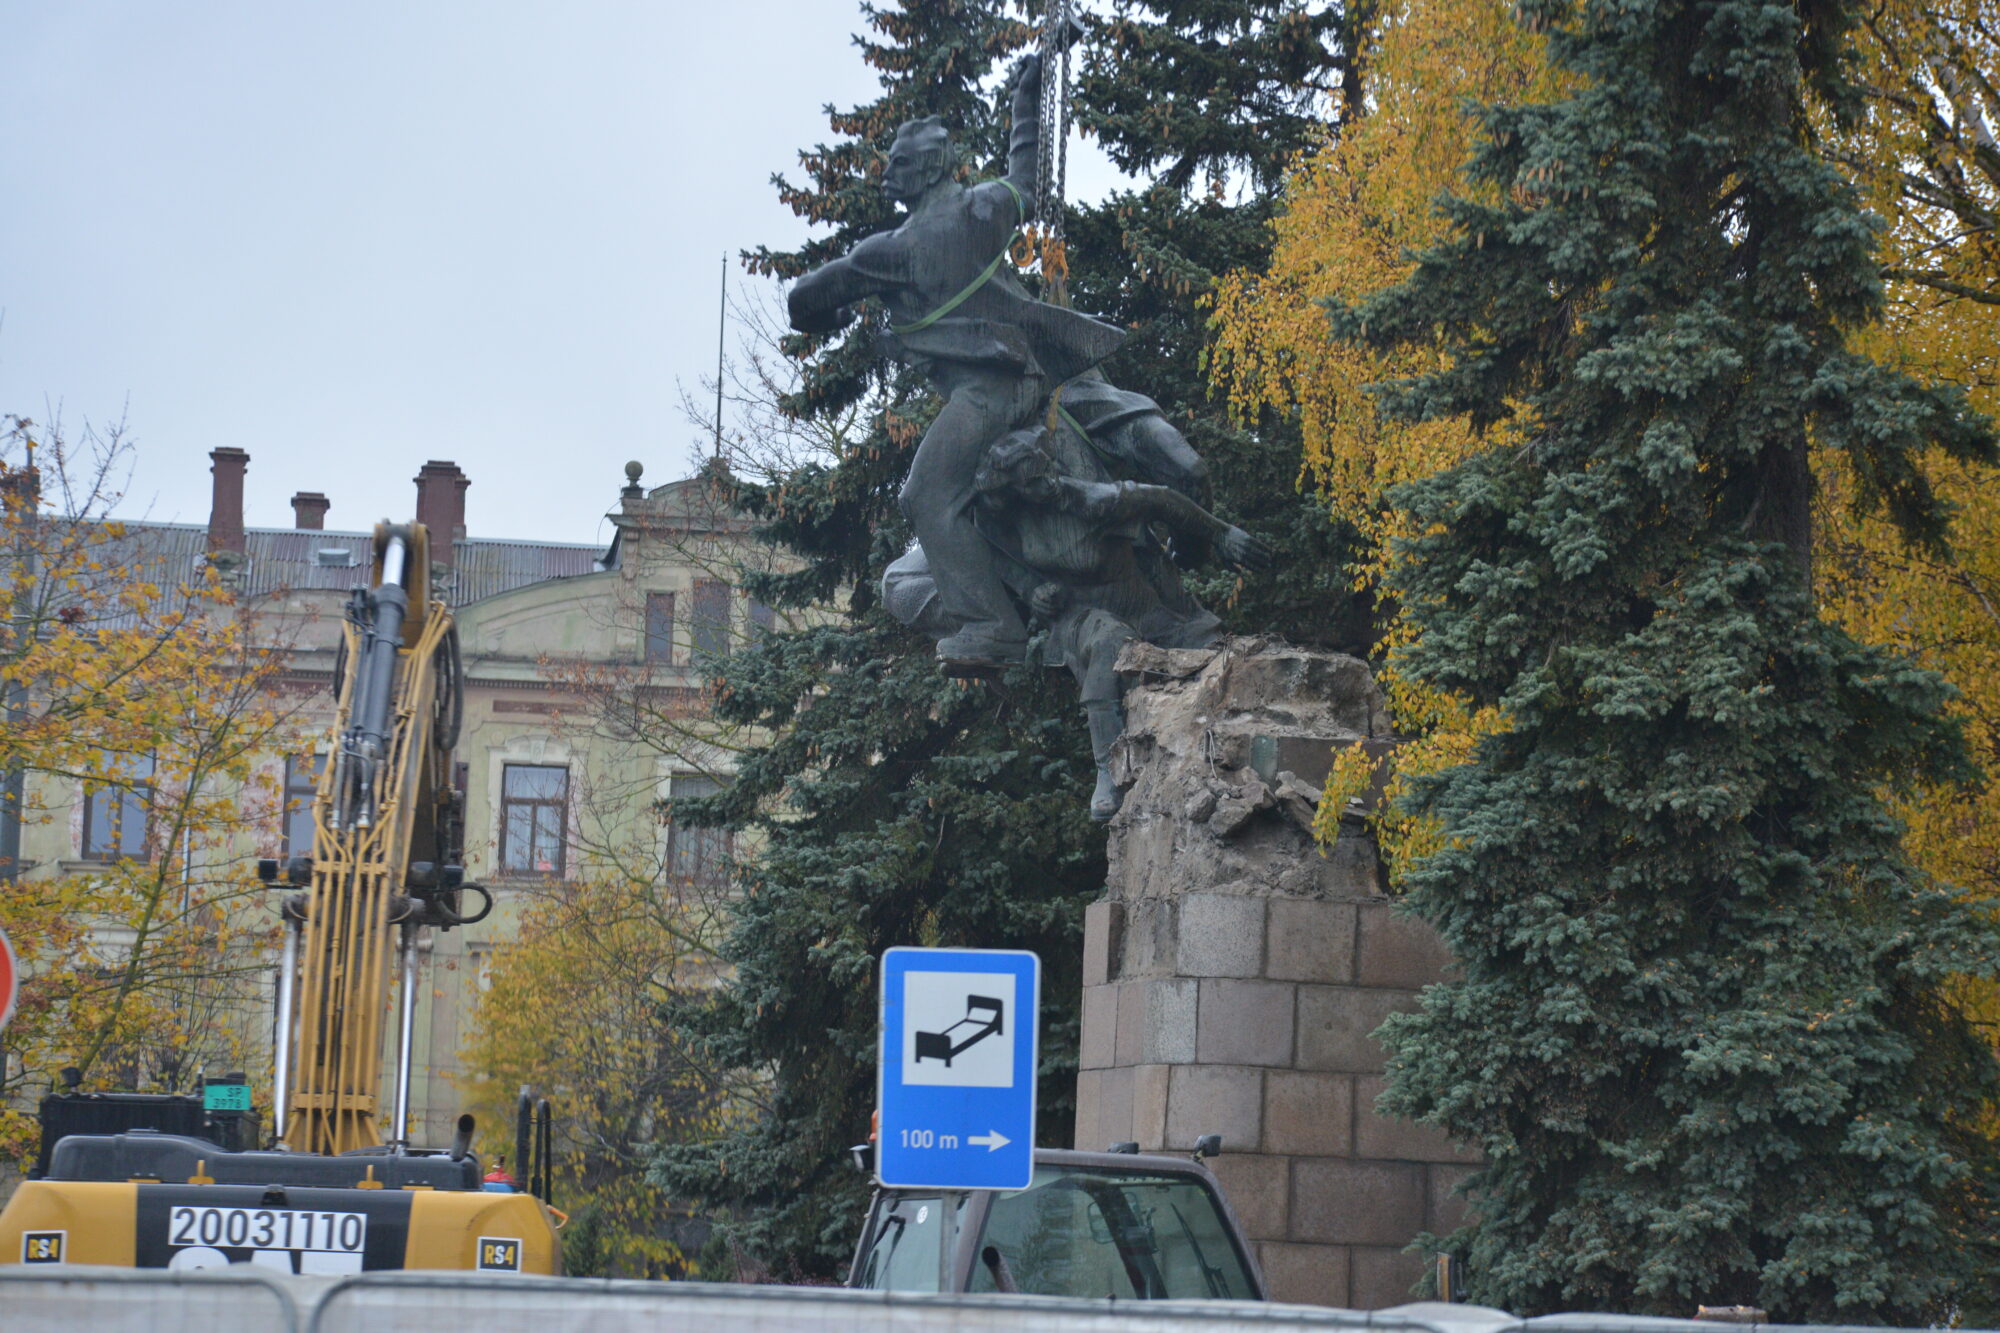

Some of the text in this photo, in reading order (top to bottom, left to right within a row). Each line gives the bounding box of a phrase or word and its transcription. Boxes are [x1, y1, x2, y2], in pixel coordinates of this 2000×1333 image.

[901, 1129, 959, 1149] 100 m
[173, 1208, 362, 1251] 20031110
[28, 1238, 59, 1259] RS4
[484, 1244, 515, 1265] RS4
